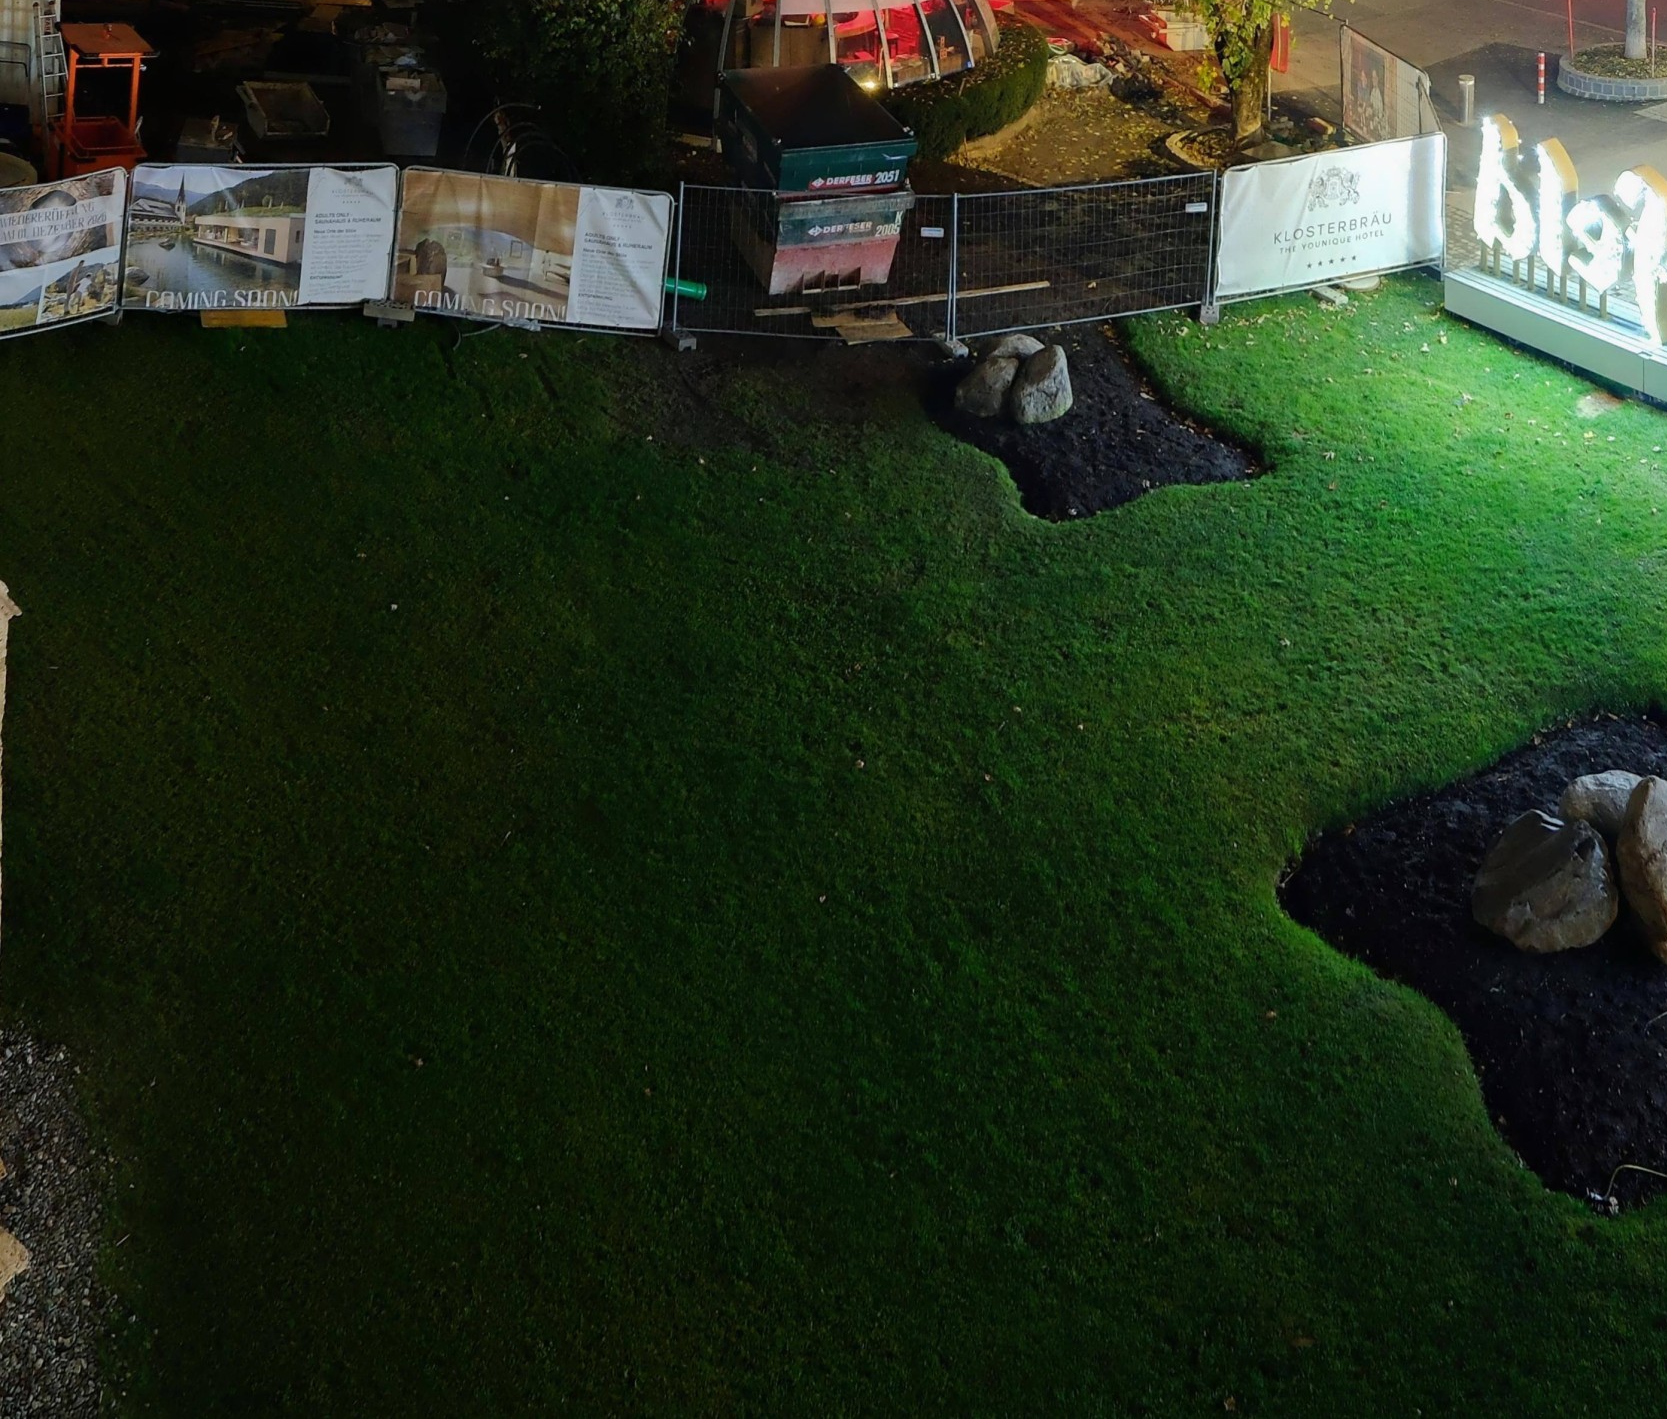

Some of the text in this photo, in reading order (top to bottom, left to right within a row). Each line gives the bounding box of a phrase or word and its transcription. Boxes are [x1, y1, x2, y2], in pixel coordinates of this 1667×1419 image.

[825, 173, 873, 186] DERFESER
[874, 169, 900, 184] 2051
[1273, 210, 1393, 244] KLOSTERBRÄU
[1279, 229, 1385, 255] THE YOUNIQUE HOTEL
[145, 289, 299, 310] COMING SOON!
[413, 289, 496, 316] COMING
[501, 299, 567, 322] SOON!
